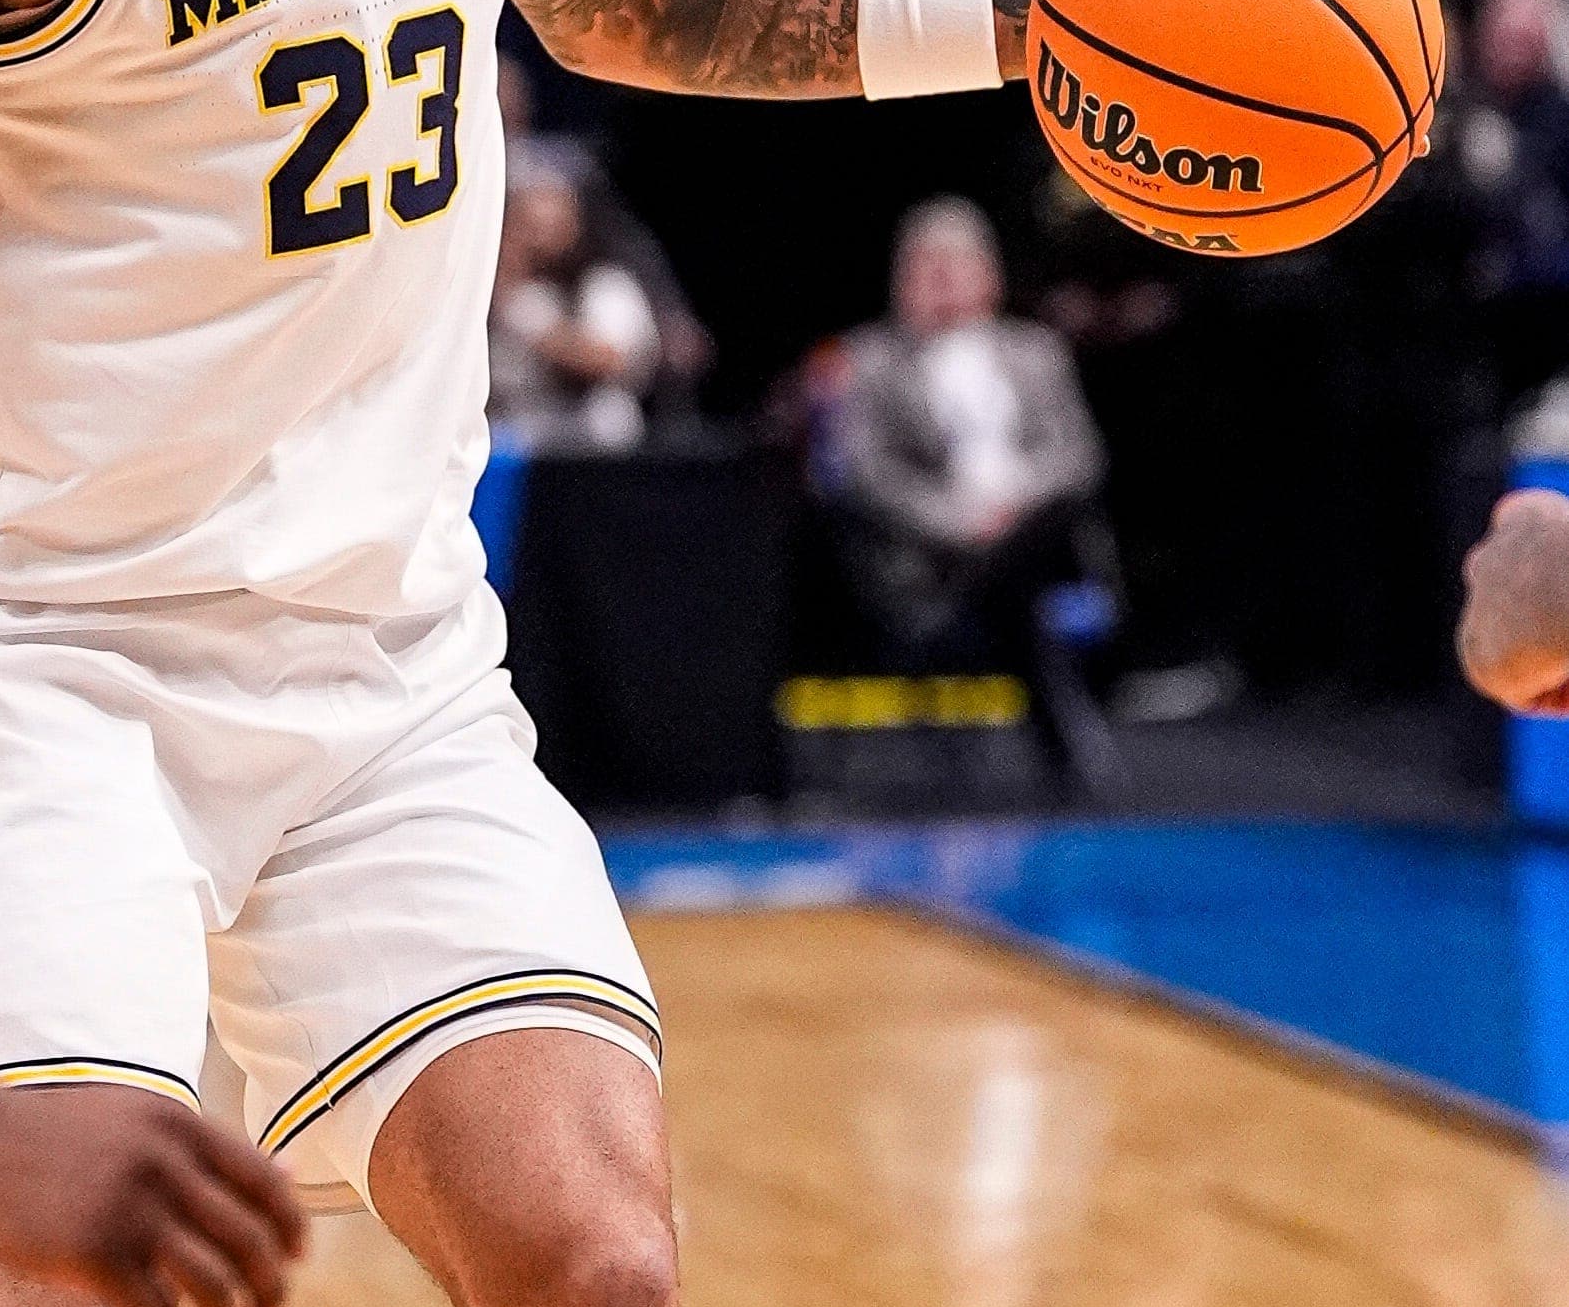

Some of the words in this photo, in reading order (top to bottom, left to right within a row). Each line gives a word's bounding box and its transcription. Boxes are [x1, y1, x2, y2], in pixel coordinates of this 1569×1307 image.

[253, 1, 467, 259] 23
[1037, 36, 1264, 194] Wilson
[1090, 156, 1123, 177] EVO
[1127, 174, 1164, 192] NXT
